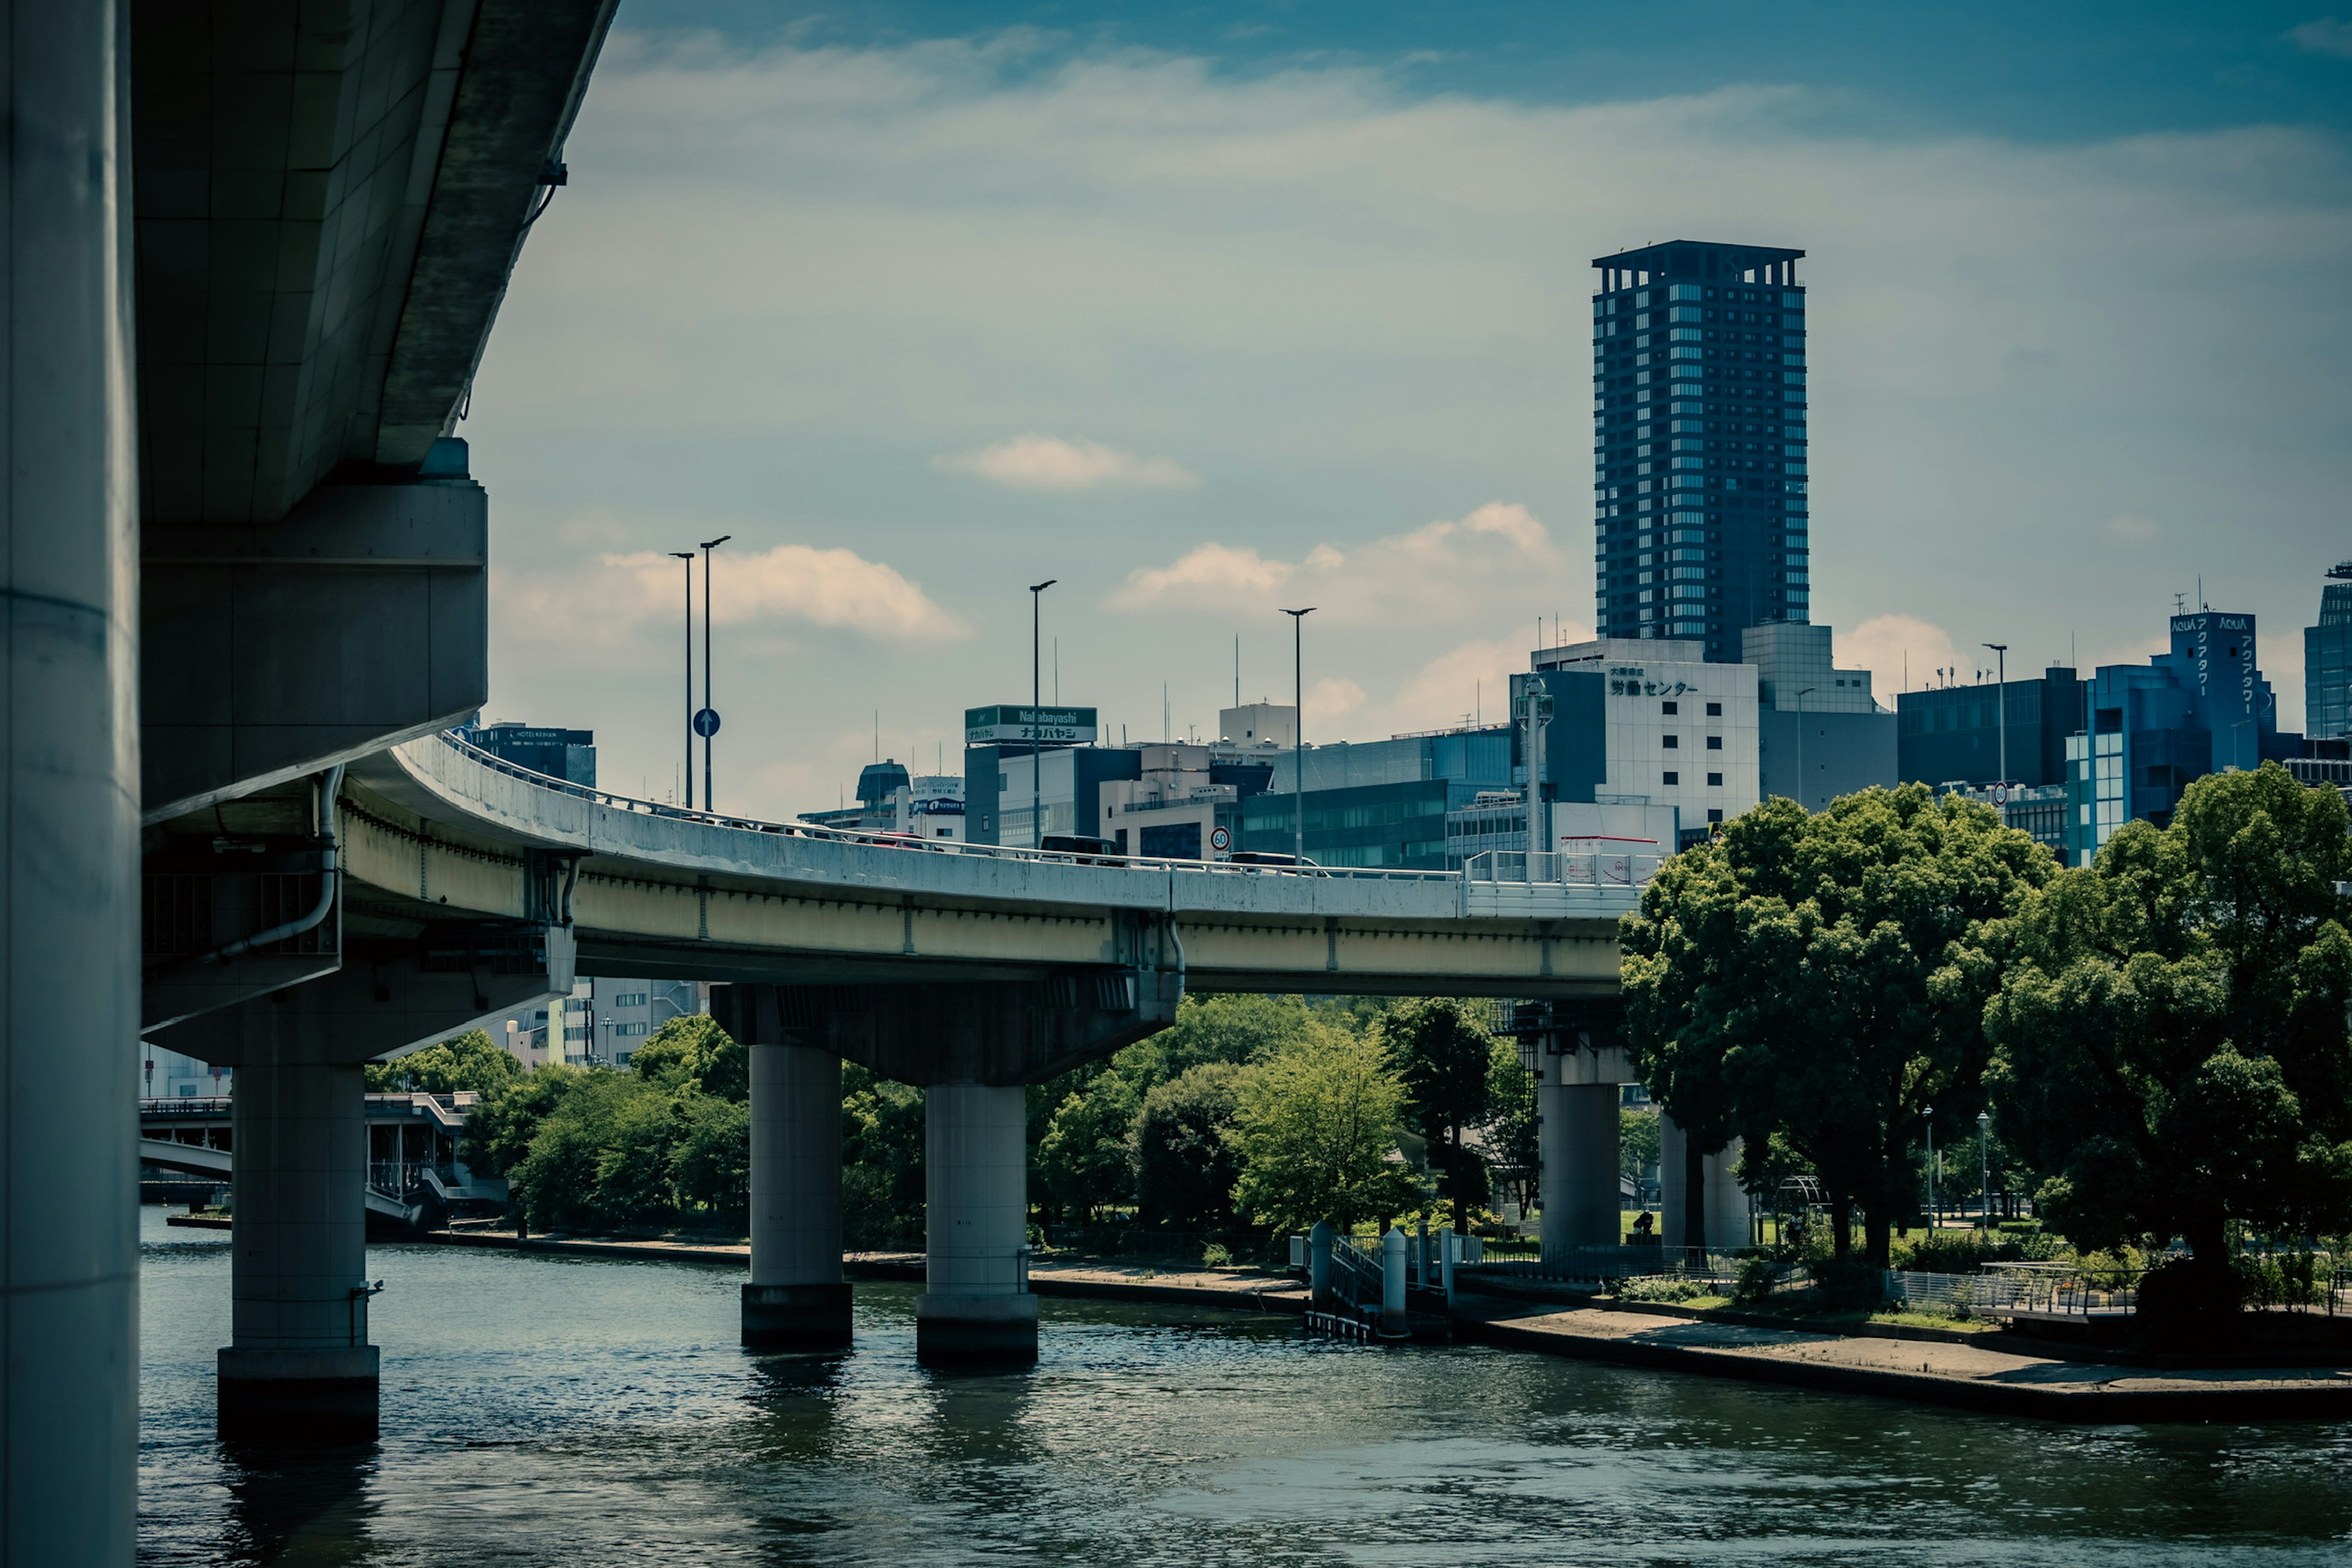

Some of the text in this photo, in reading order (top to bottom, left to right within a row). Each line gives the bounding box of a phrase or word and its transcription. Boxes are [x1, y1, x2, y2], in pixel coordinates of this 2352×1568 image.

[2198, 618, 2207, 696] アクアタワー
[2242, 635, 2253, 714] アクアタワー
[1611, 680, 1698, 696] 労働センター
[1997, 788, 2003, 799] 60
[1215, 834, 1226, 844] 60
